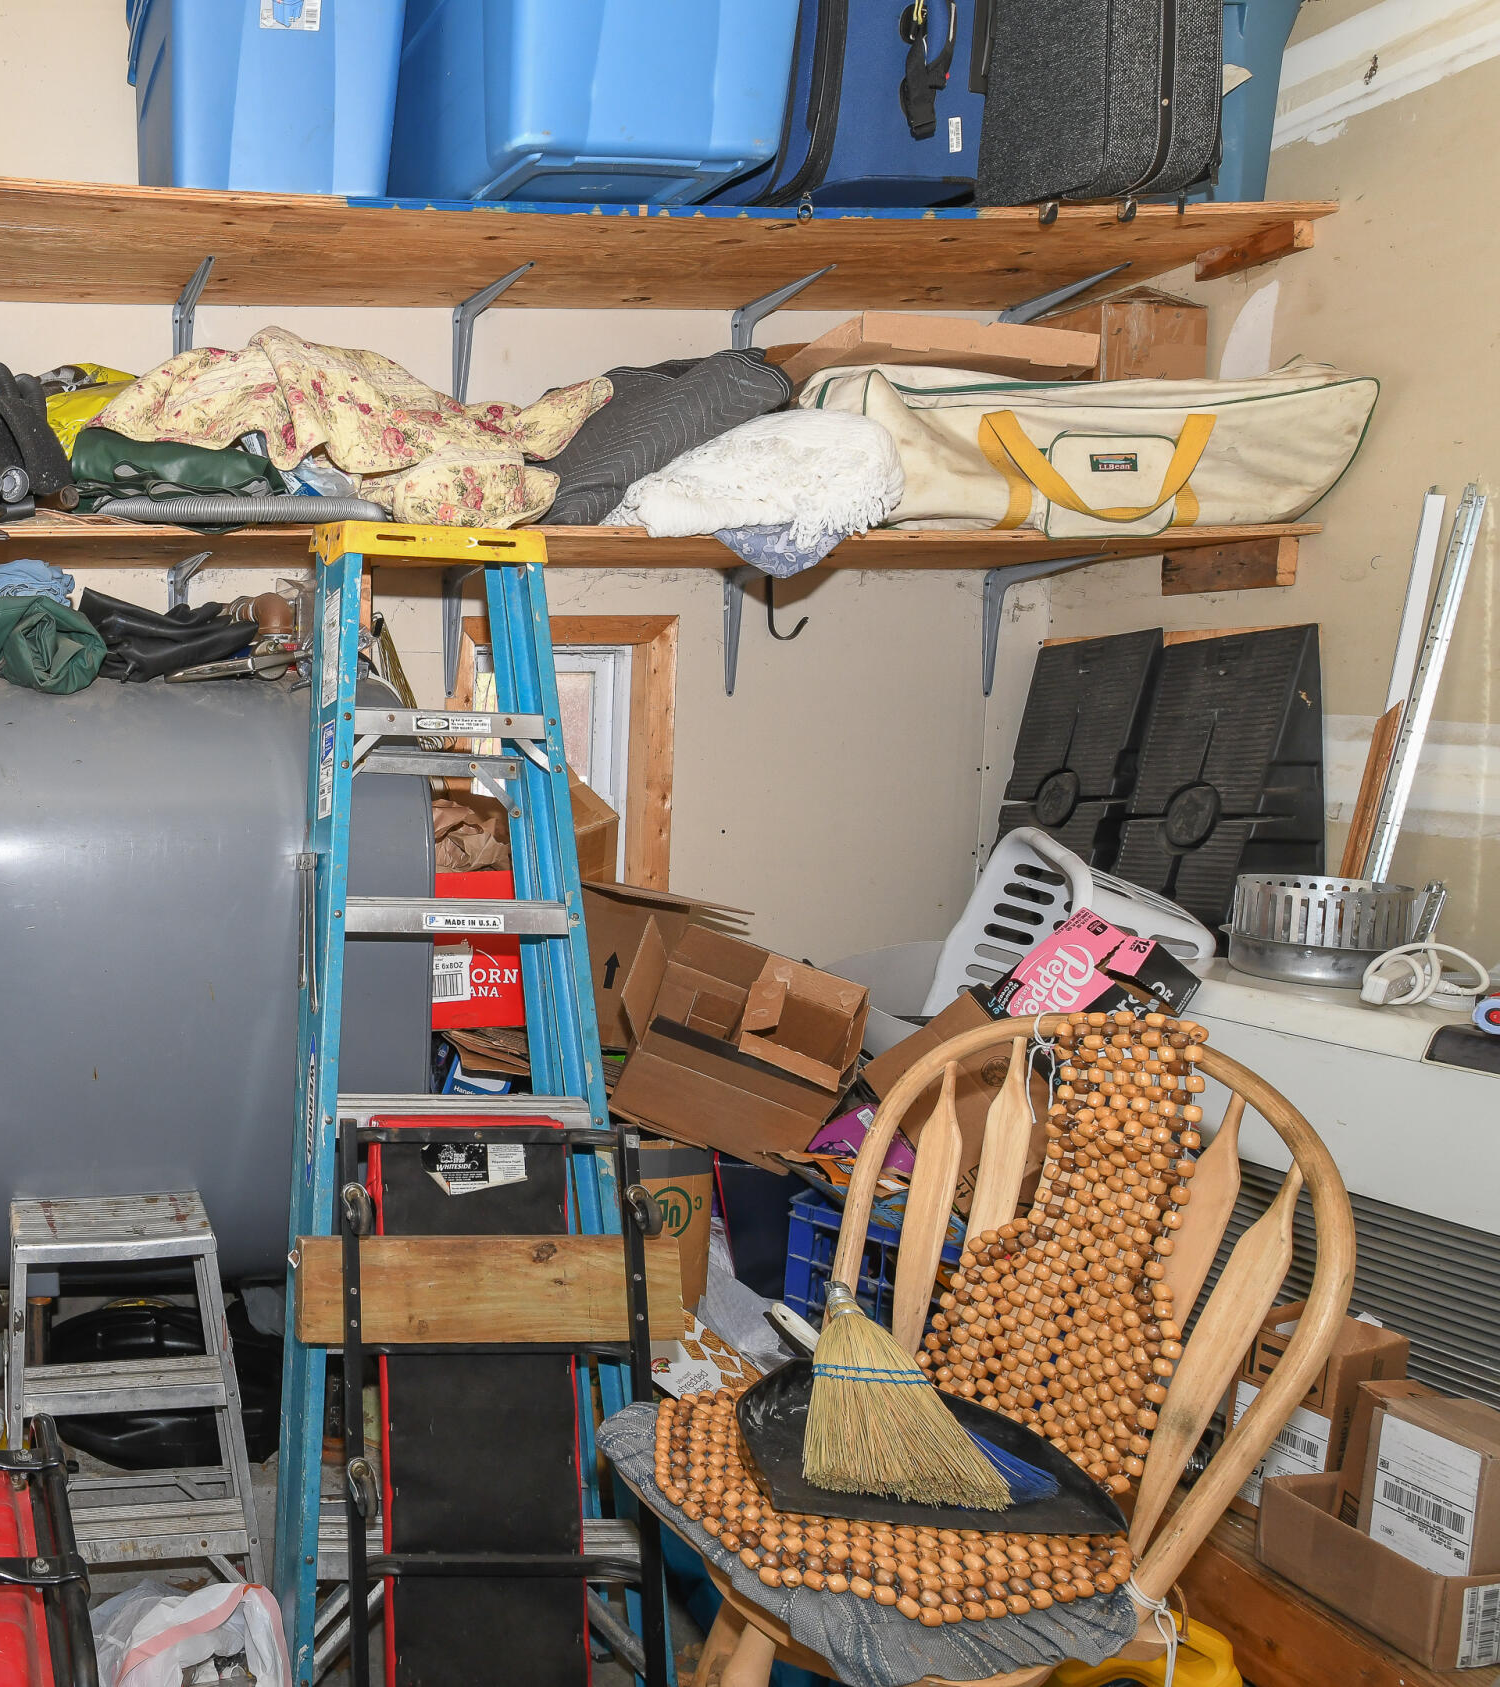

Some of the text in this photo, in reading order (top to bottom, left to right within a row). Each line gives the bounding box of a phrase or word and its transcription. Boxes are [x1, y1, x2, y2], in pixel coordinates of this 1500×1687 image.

[444, 918, 466, 926] MADE
[478, 919, 499, 927] U.S.A.
[1133, 939, 1151, 955] 12
[471, 968, 519, 984] ORN
[470, 985, 503, 998] ANA.
[307, 1063, 316, 1159] WERNER
[436, 1163, 472, 1172] WHITESIDE
[677, 1368, 709, 1395] shredded
